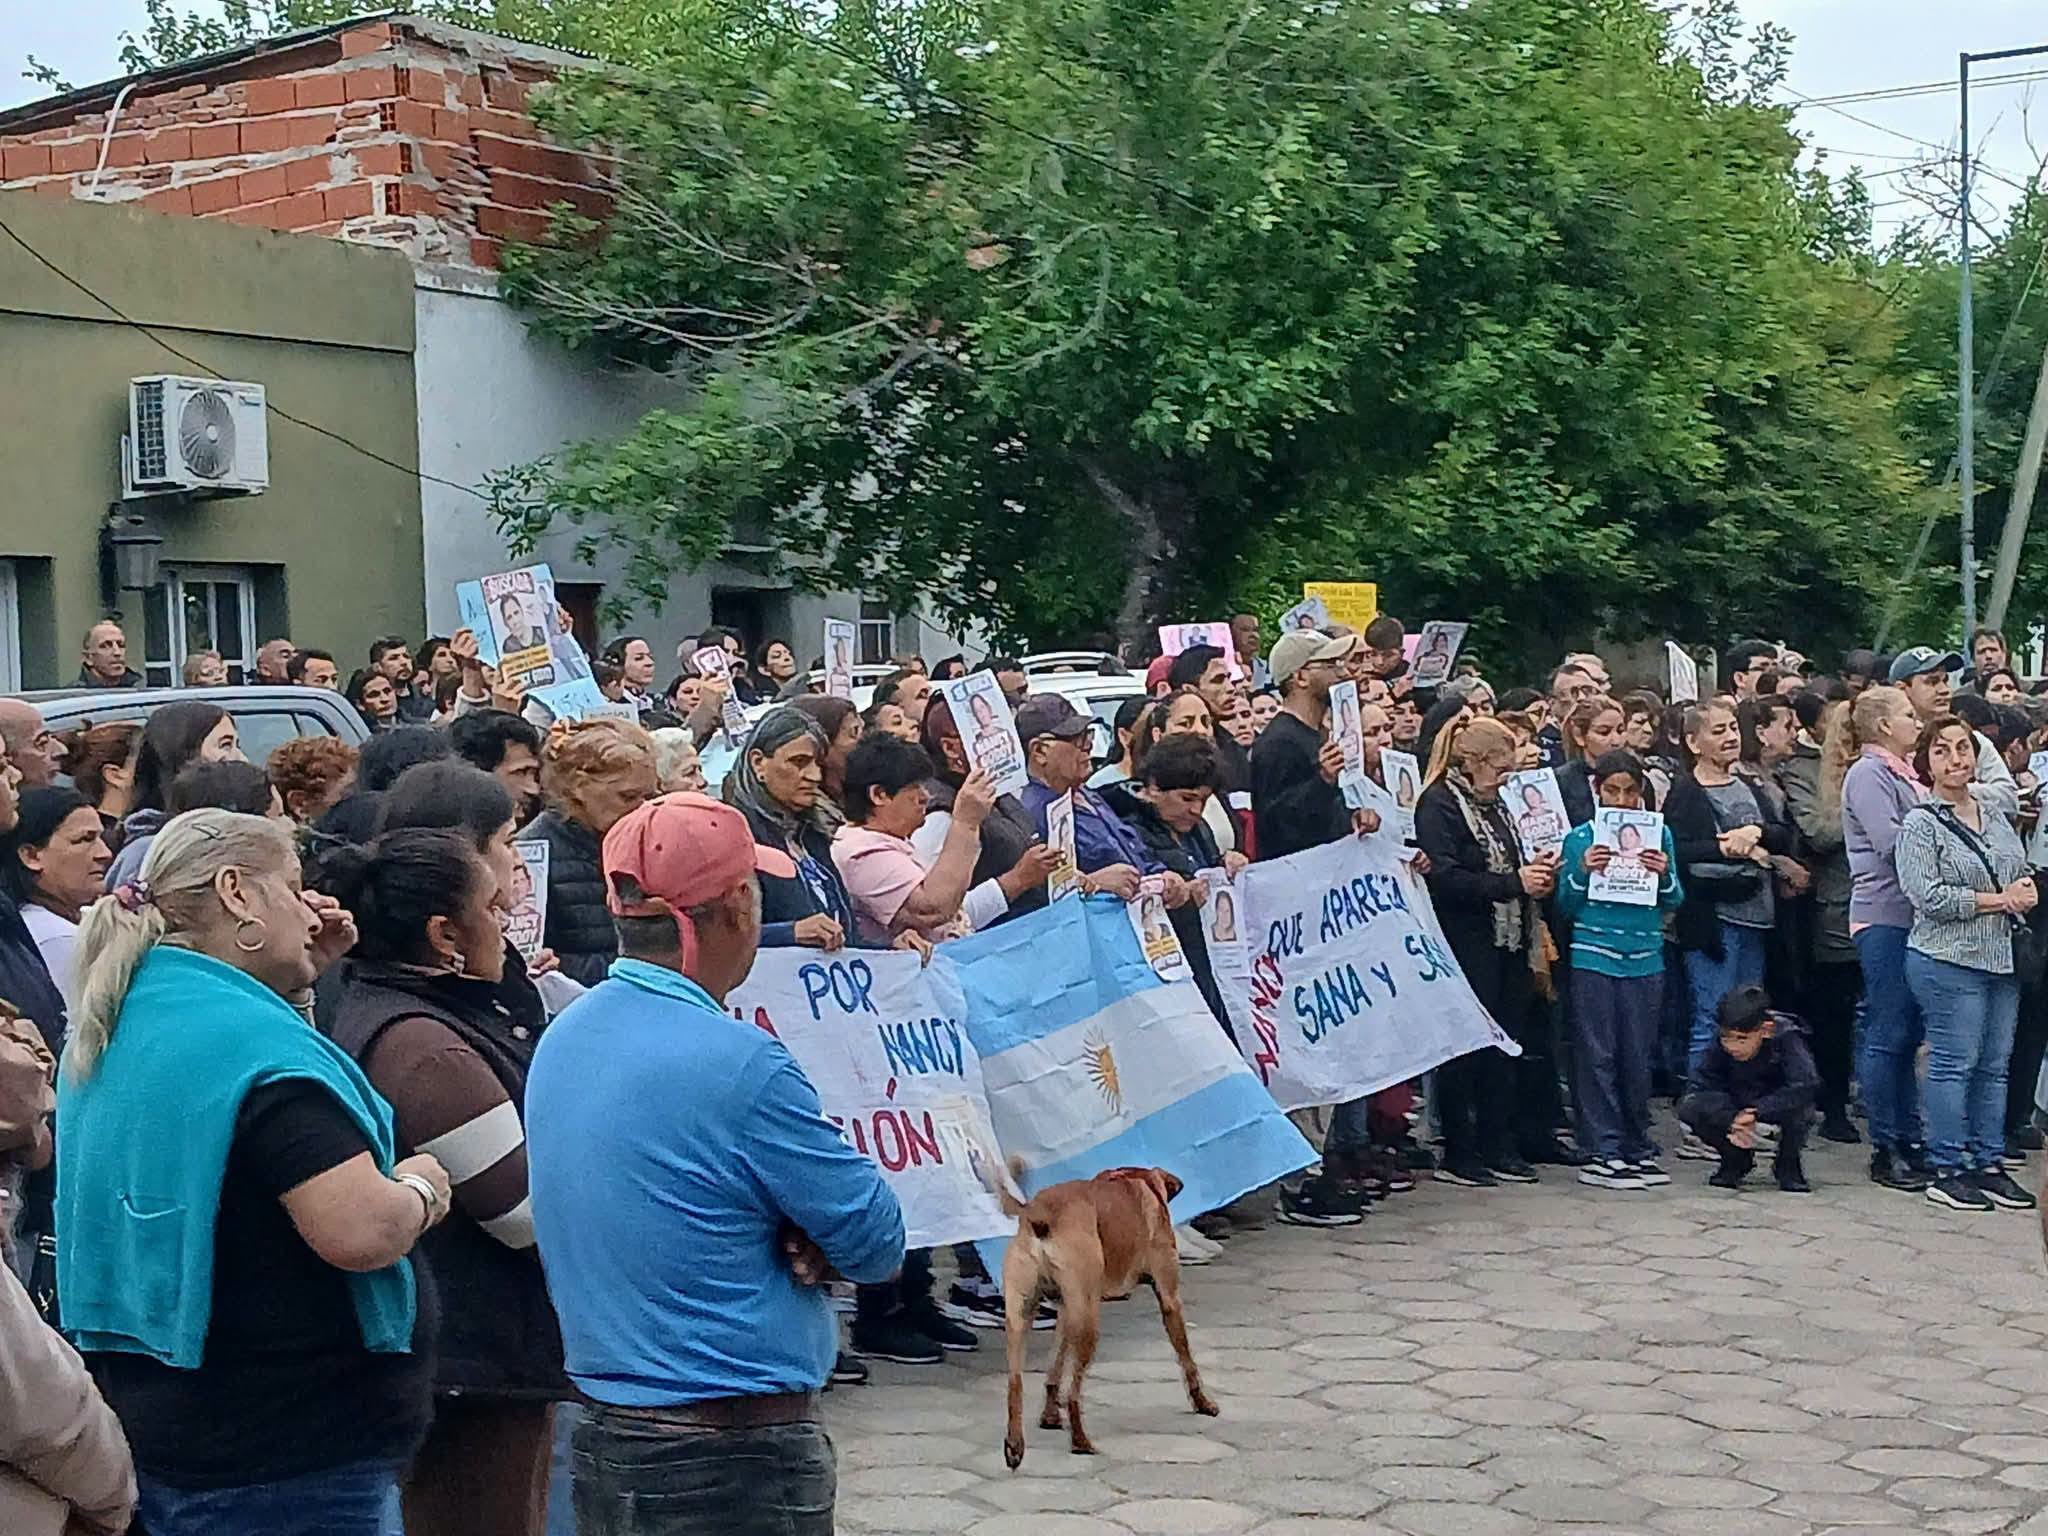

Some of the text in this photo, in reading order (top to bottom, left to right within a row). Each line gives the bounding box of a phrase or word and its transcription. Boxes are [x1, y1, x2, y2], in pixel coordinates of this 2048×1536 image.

[1267, 911, 1304, 963] QUE
[799, 957, 879, 1020] POR
[1294, 963, 1373, 1044] SANA
[1370, 961, 1397, 998] Y
[878, 1018, 964, 1080] NANCY
[828, 1077, 943, 1172] IÓN
